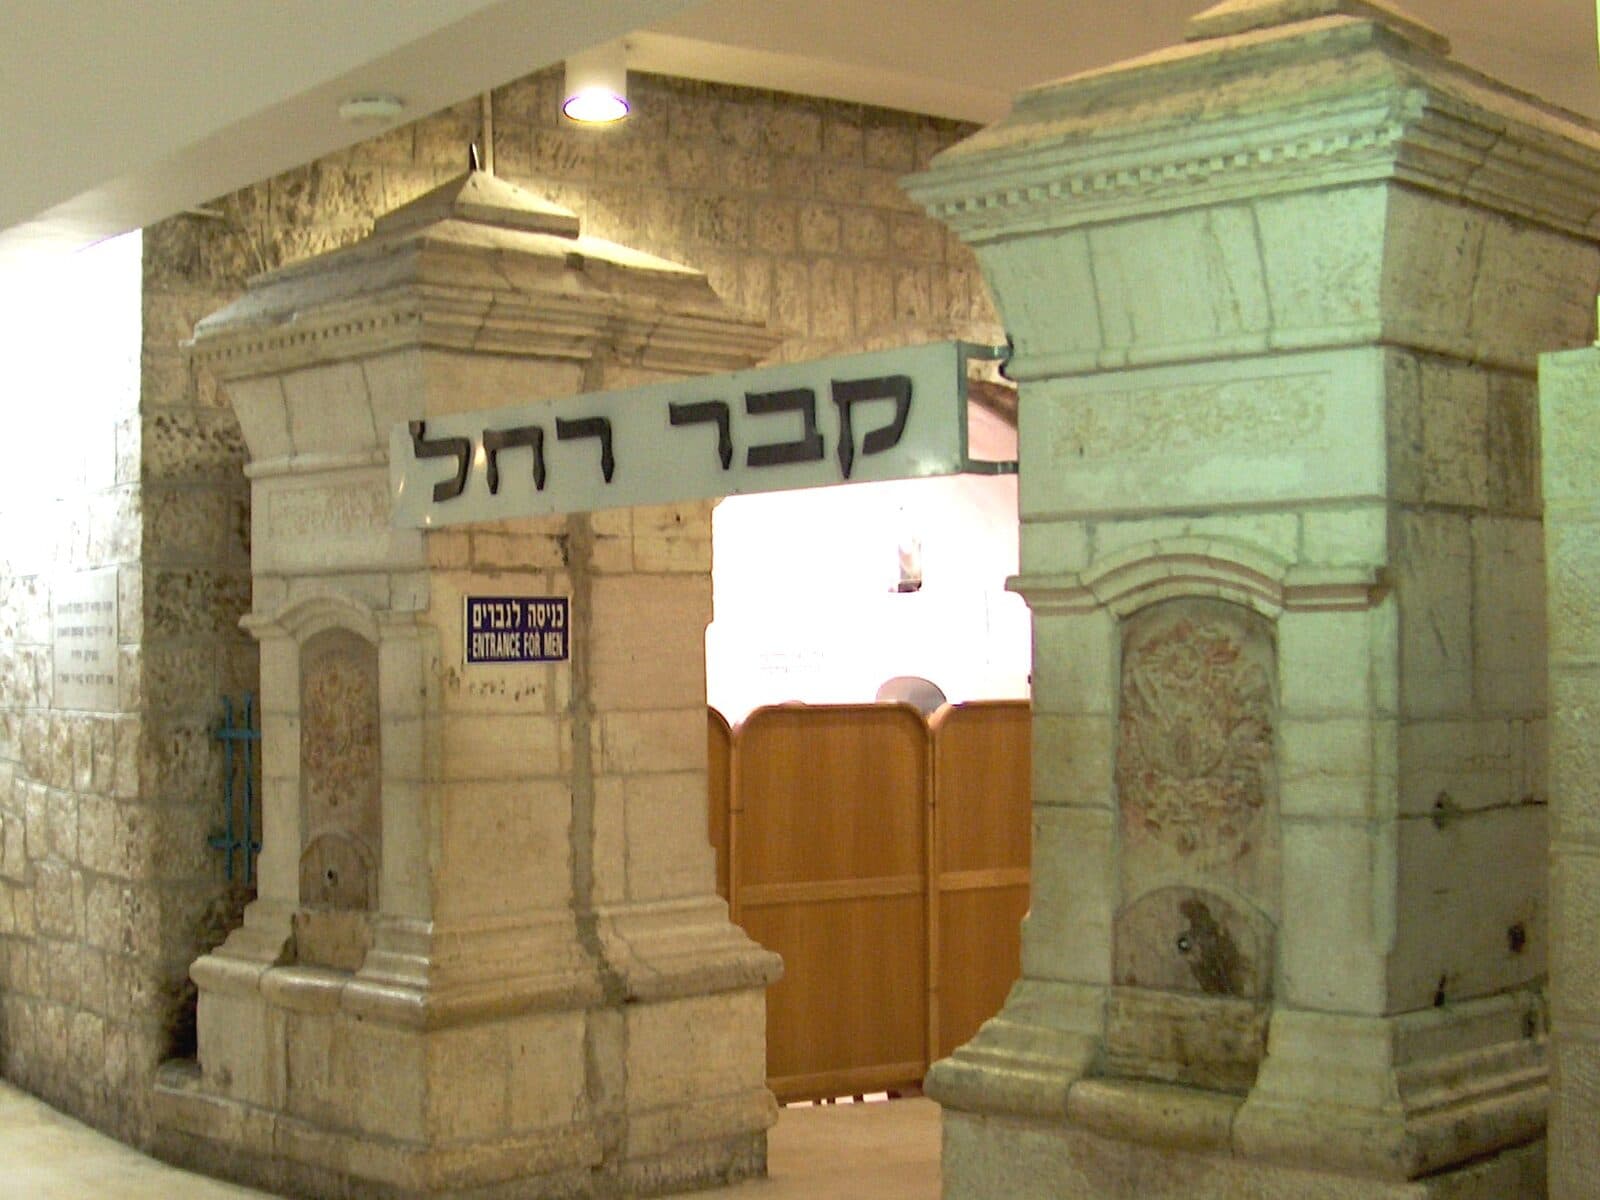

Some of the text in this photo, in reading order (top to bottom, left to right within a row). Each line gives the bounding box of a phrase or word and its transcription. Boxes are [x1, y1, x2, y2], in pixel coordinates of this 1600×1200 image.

[410, 374, 913, 503] קבר רחל
[473, 600, 564, 629] כניסה לגברים
[472, 632, 563, 658] ENTRANCE FOR MEN
